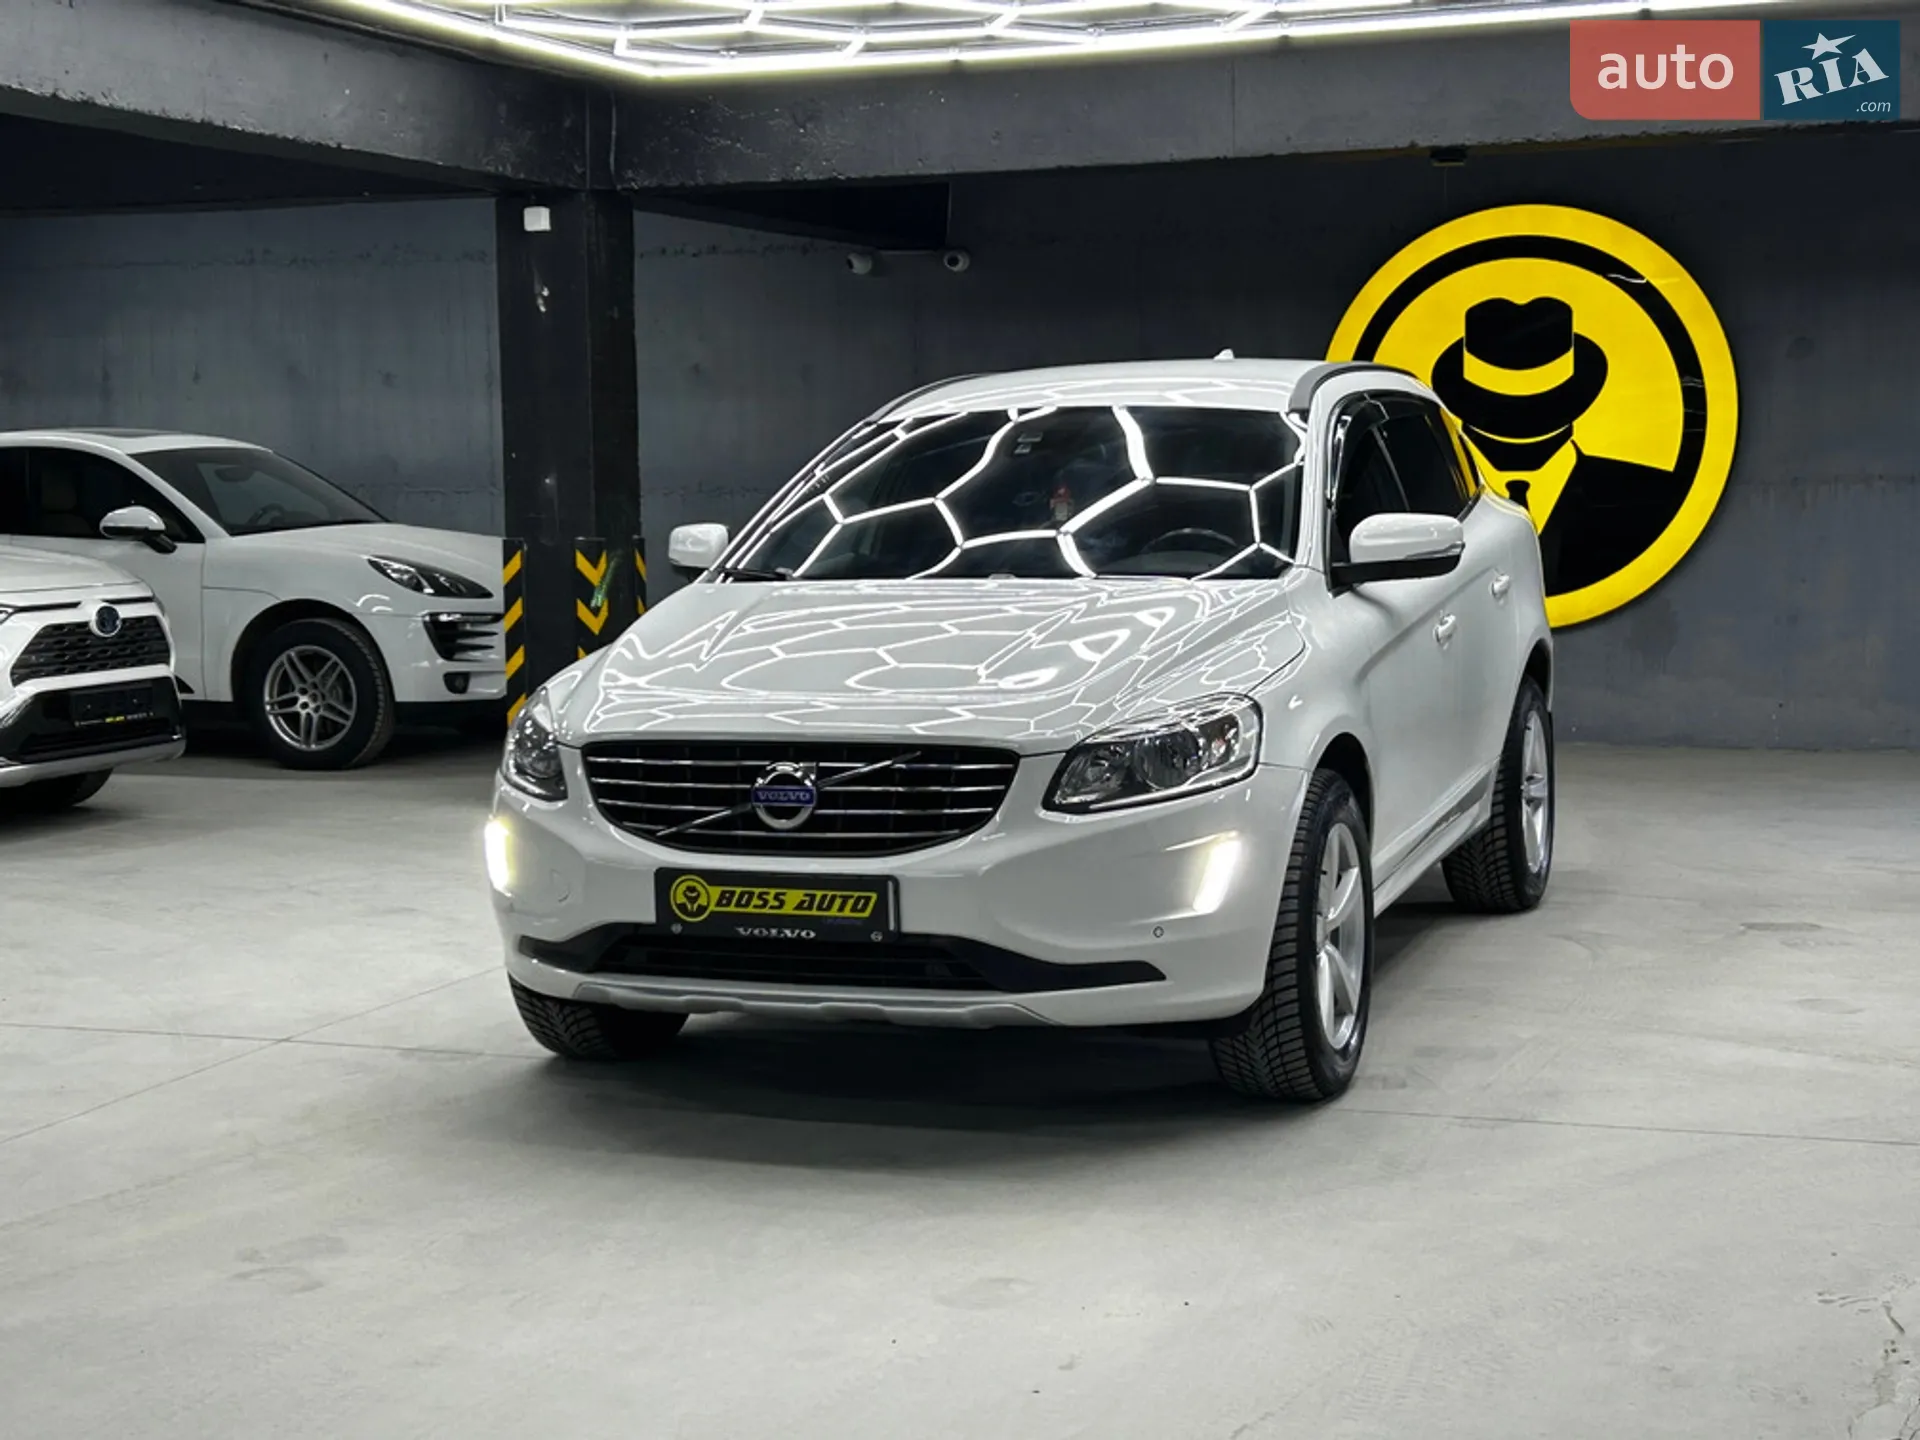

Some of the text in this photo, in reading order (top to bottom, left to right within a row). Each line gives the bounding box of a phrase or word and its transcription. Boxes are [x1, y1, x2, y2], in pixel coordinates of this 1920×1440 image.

[756, 790, 811, 801] VOLVO
[716, 889, 874, 914] BOSS AUTO
[735, 926, 816, 940] VOLVO
